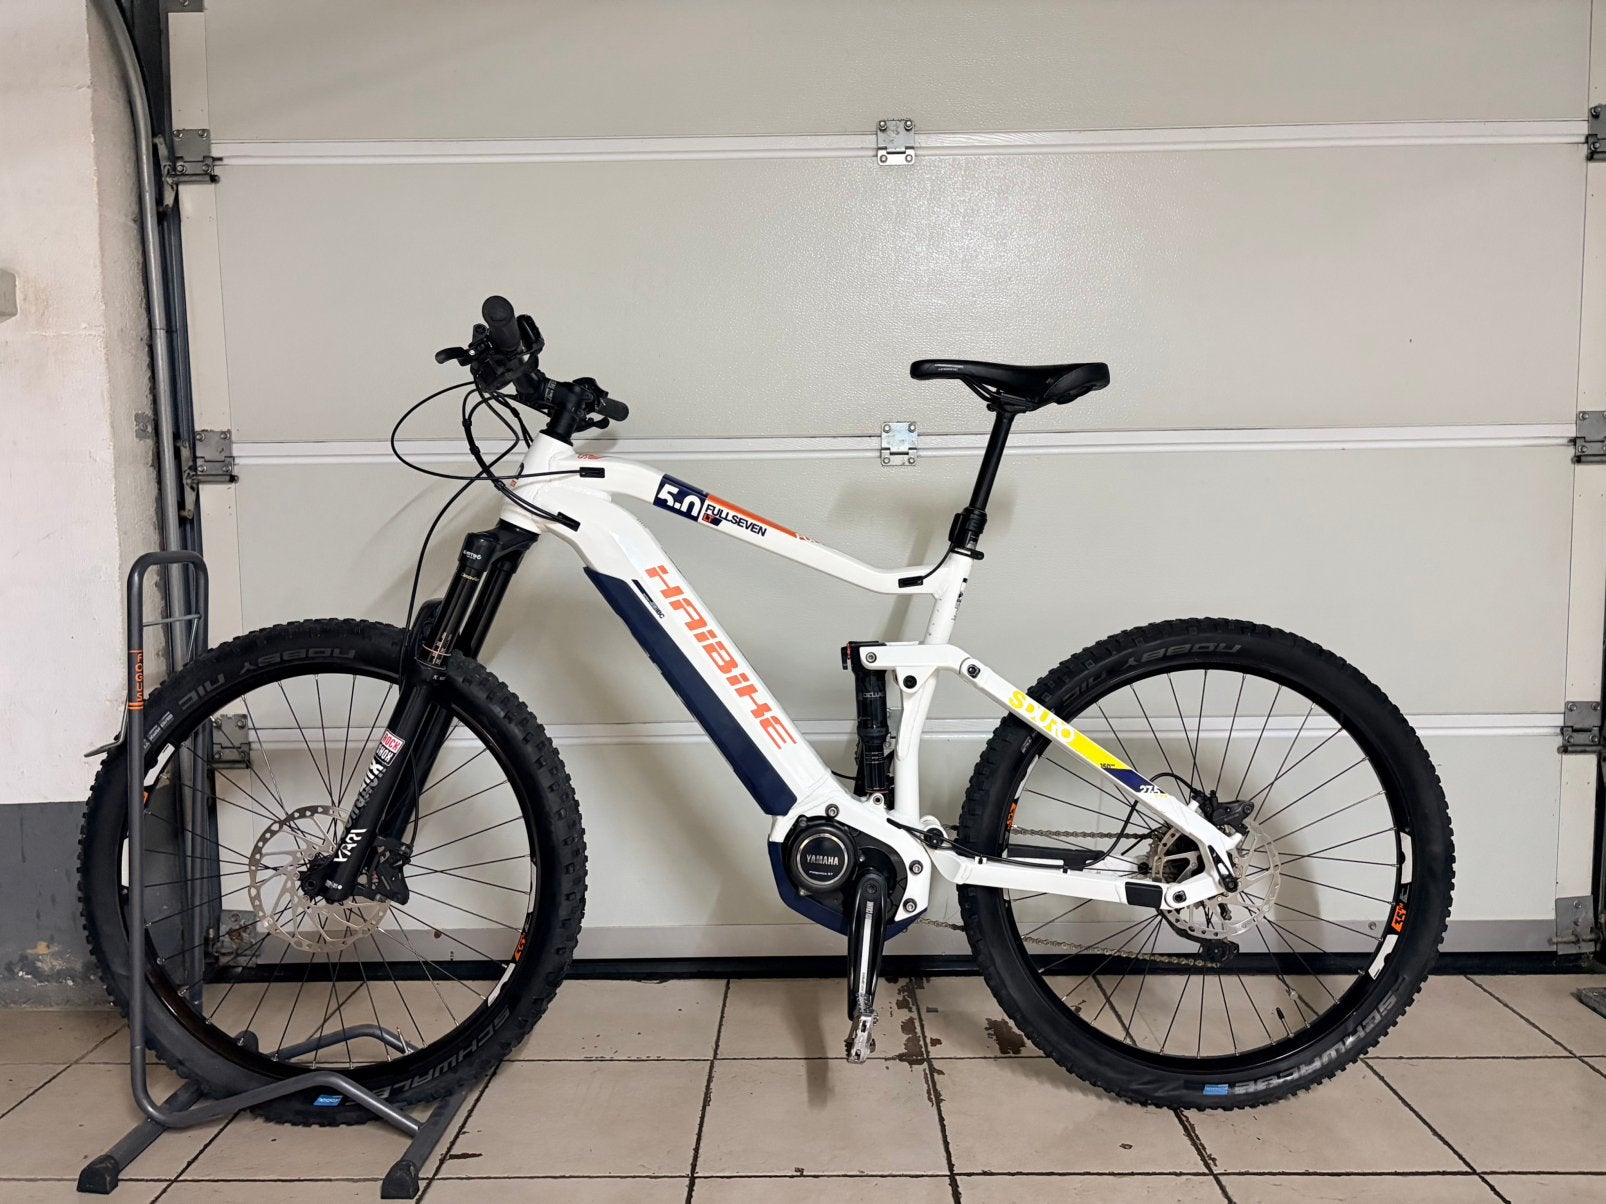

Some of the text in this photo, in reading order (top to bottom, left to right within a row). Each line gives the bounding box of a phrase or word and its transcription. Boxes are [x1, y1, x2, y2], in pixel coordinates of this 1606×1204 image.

[657, 483, 701, 517] 5.0
[705, 504, 767, 537] FULLSEVEN
[1120, 642, 1243, 670] NOBBY
[178, 647, 356, 711] NOBBY NIC
[383, 732, 402, 753] ROCK
[333, 827, 368, 863] YARI
[806, 853, 839, 866] YAMAHA
[345, 1004, 510, 1106] SCHWALB
[1232, 990, 1398, 1096] SCHWALBE
